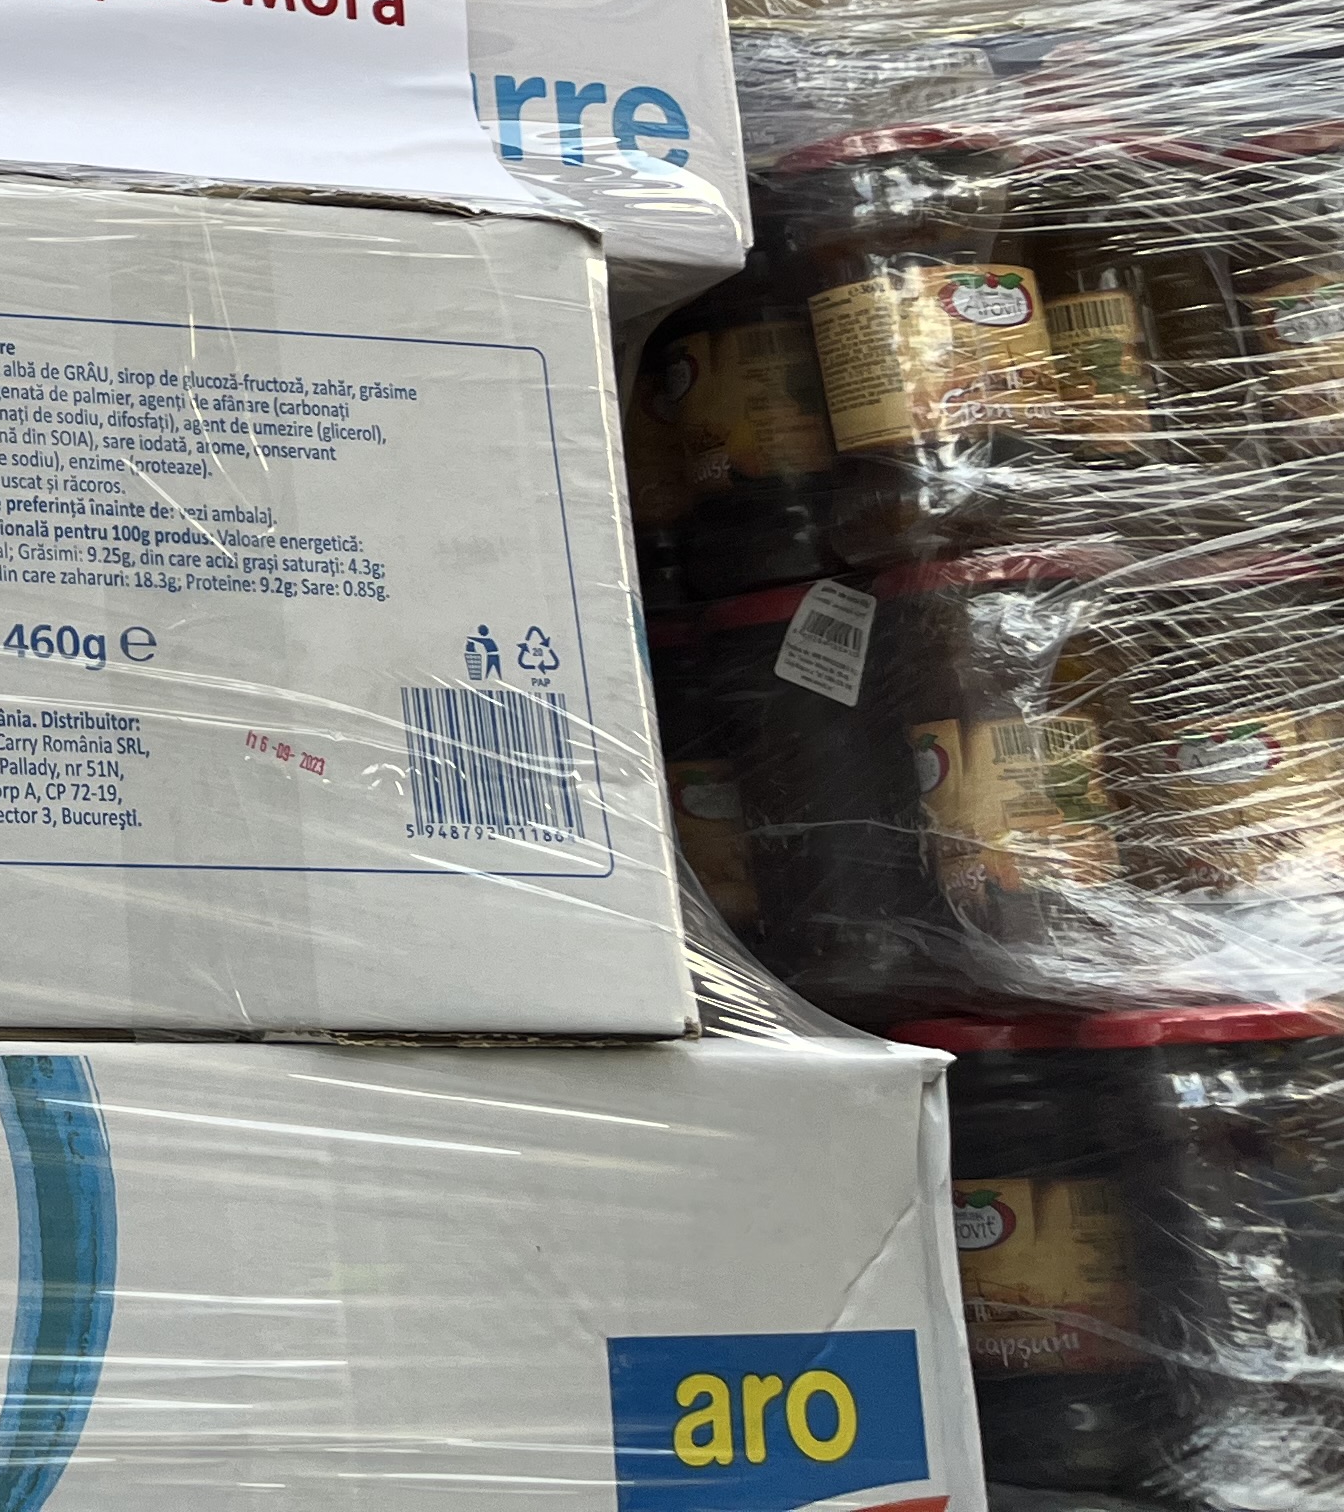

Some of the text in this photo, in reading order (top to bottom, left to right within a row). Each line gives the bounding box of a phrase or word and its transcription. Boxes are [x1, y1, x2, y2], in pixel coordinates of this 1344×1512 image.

[470, 70, 690, 176] rre
[23, 570, 55, 583] care
[60, 568, 129, 587] zaharuri:
[135, 572, 181, 593] 18.3g;
[187, 574, 256, 592] Proteine:
[260, 577, 297, 598] 9.2g;
[302, 579, 339, 595] Sare:
[344, 581, 389, 602] 0.85g.
[3, 623, 107, 670] 460g
[41, 710, 140, 731] Distribuitor:
[43, 735, 112, 753] România
[117, 737, 149, 758] SRL,
[673, 1369, 857, 1466] aro
